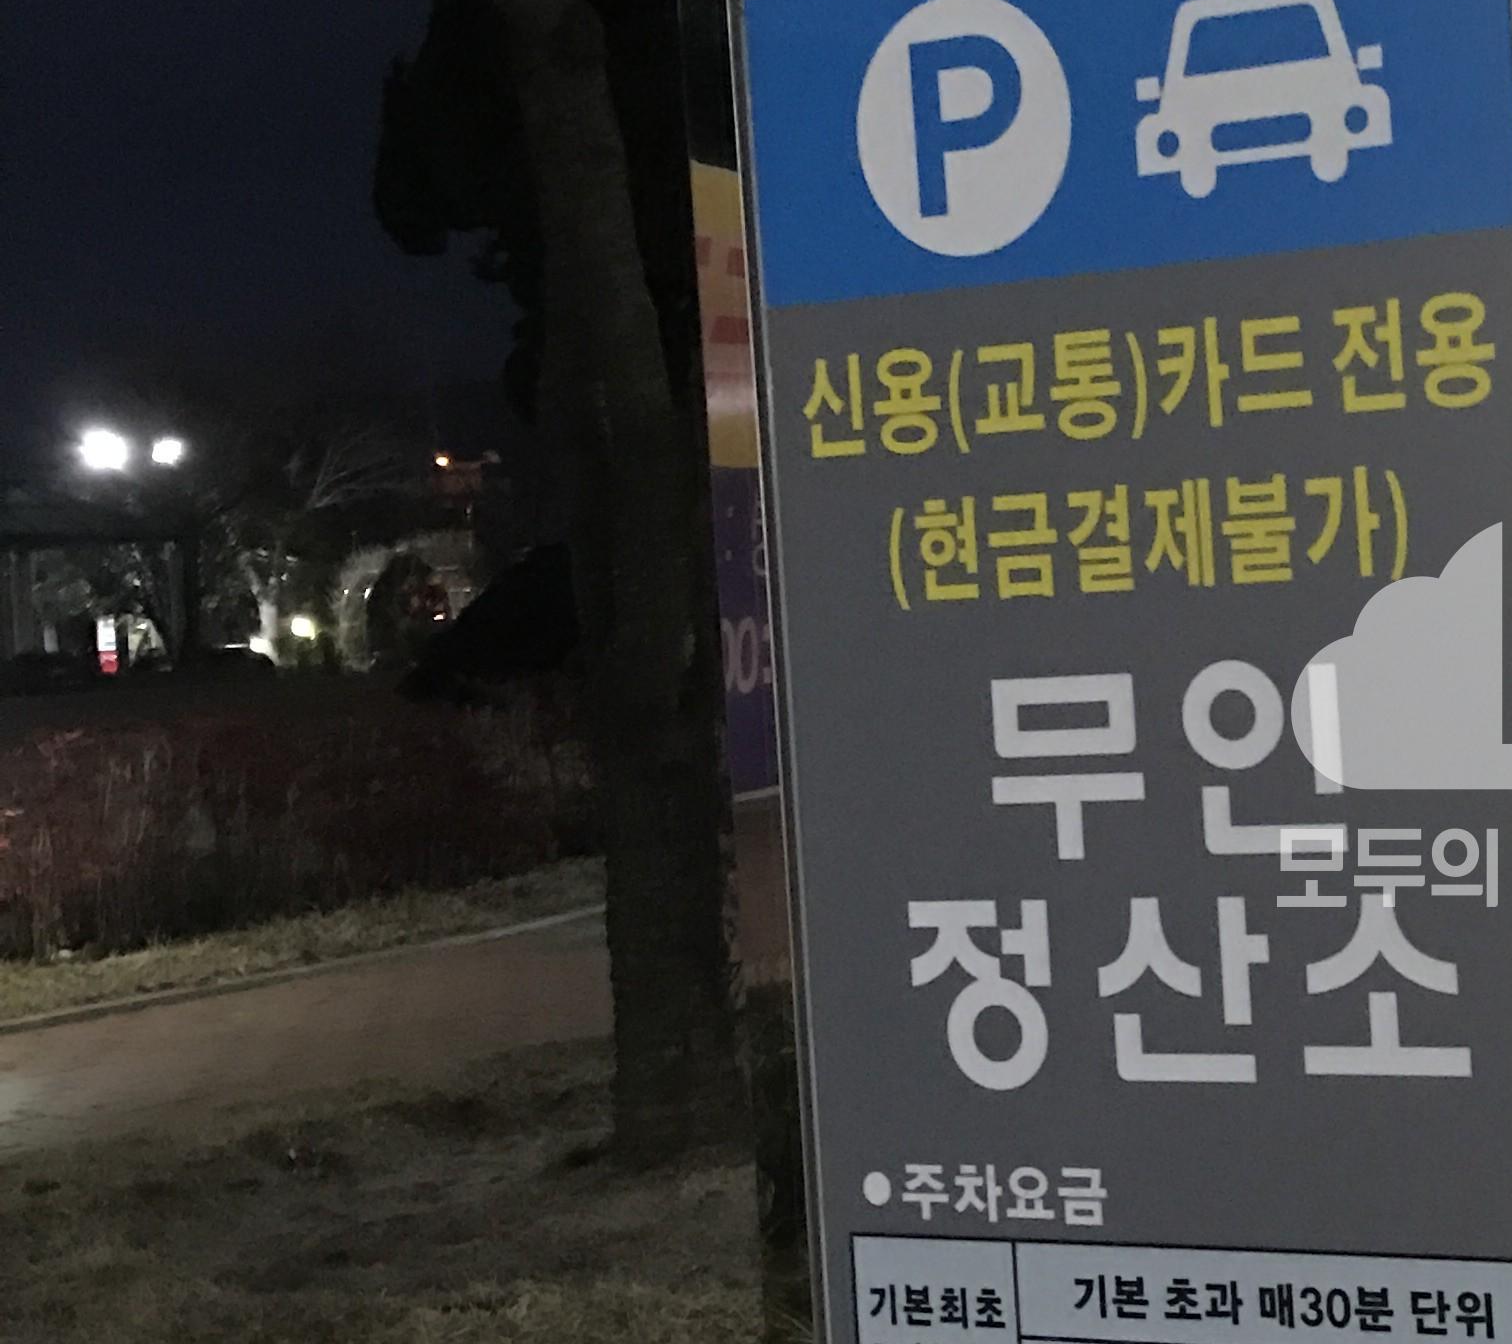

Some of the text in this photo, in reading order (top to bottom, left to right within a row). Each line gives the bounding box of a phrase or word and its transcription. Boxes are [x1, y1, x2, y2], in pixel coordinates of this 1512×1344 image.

[908, 32, 1022, 219] P
[802, 314, 1313, 458] 신용(교통)카드
[1334, 291, 1497, 416] 전용
[888, 468, 1409, 611] (현금결제불가)
[990, 659, 1349, 860] 무인
[907, 892, 1473, 1090] 정산소
[900, 1163, 1109, 1226] 주차요금
[868, 1284, 1008, 1331] 기본최초
[1073, 1275, 1497, 1340] 기본 초과 매30분 단위
